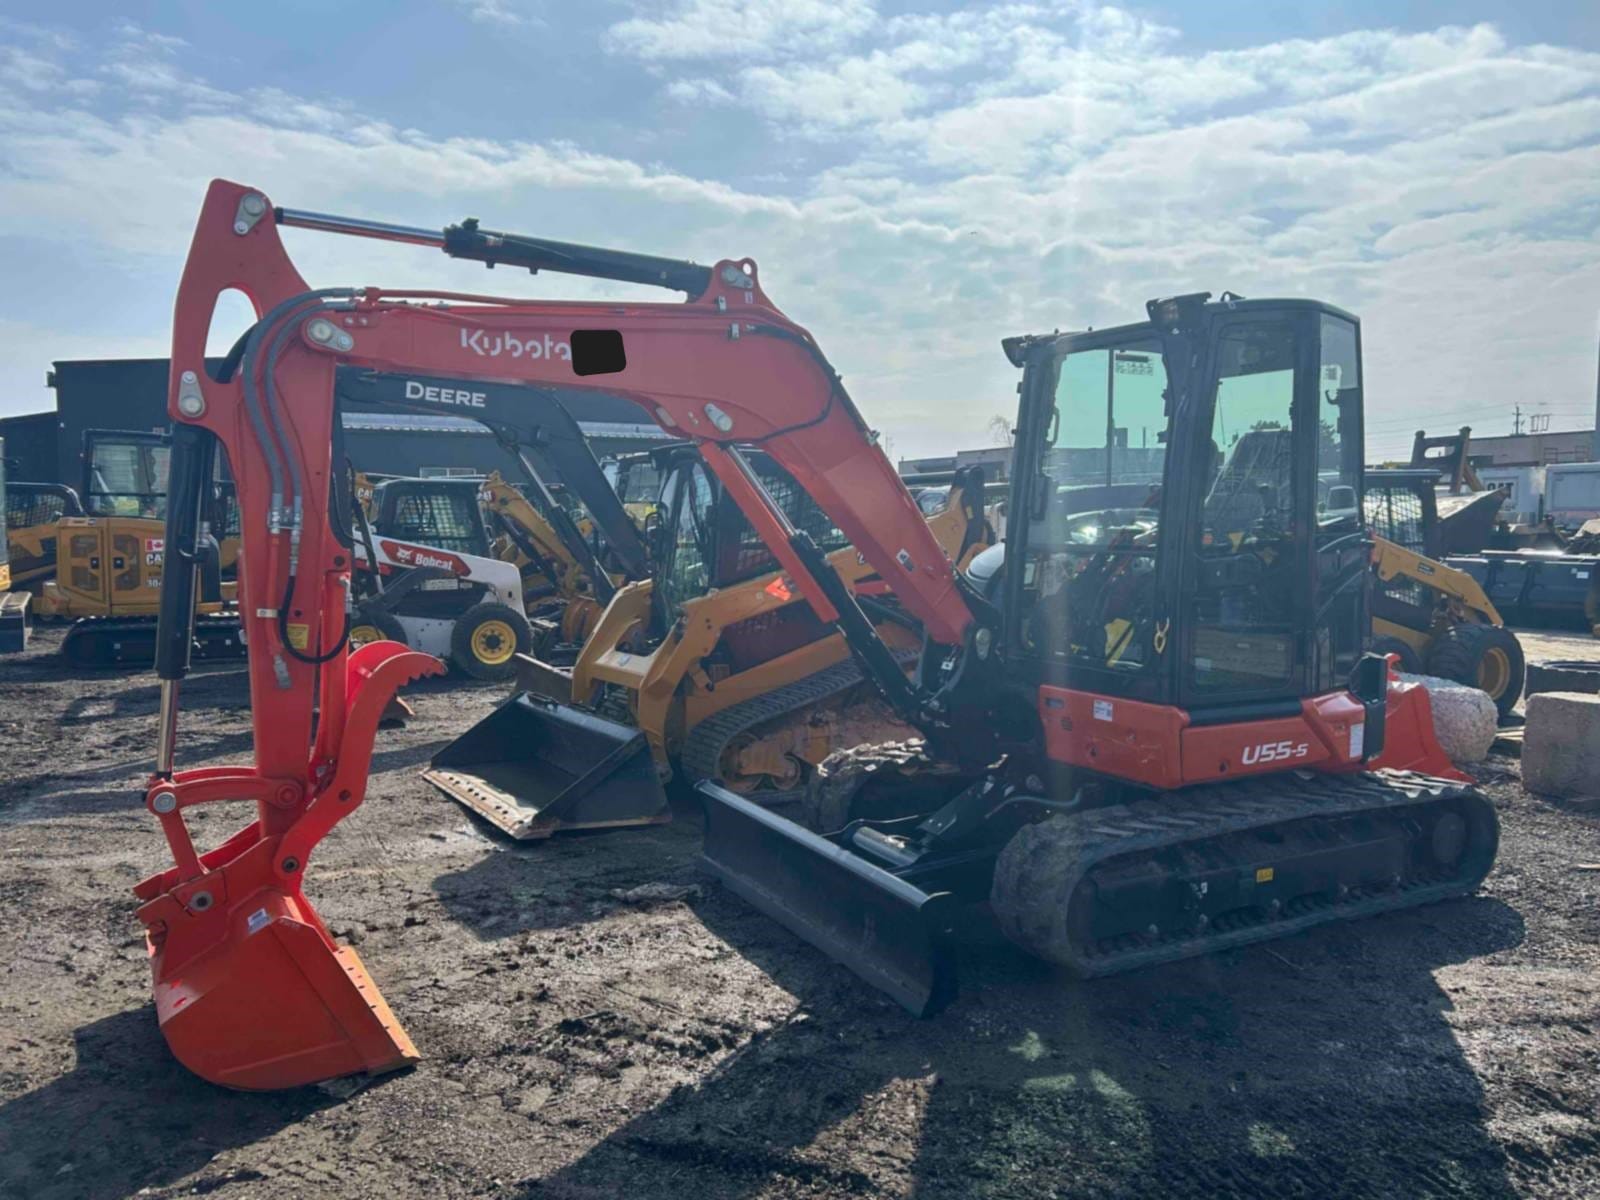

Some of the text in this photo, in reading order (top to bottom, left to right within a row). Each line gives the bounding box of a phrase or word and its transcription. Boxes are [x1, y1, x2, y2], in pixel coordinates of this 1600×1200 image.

[460, 327, 572, 361] Kubota
[405, 380, 487, 408] DEERE
[145, 553, 164, 566] CA
[415, 553, 453, 571] Bobcat
